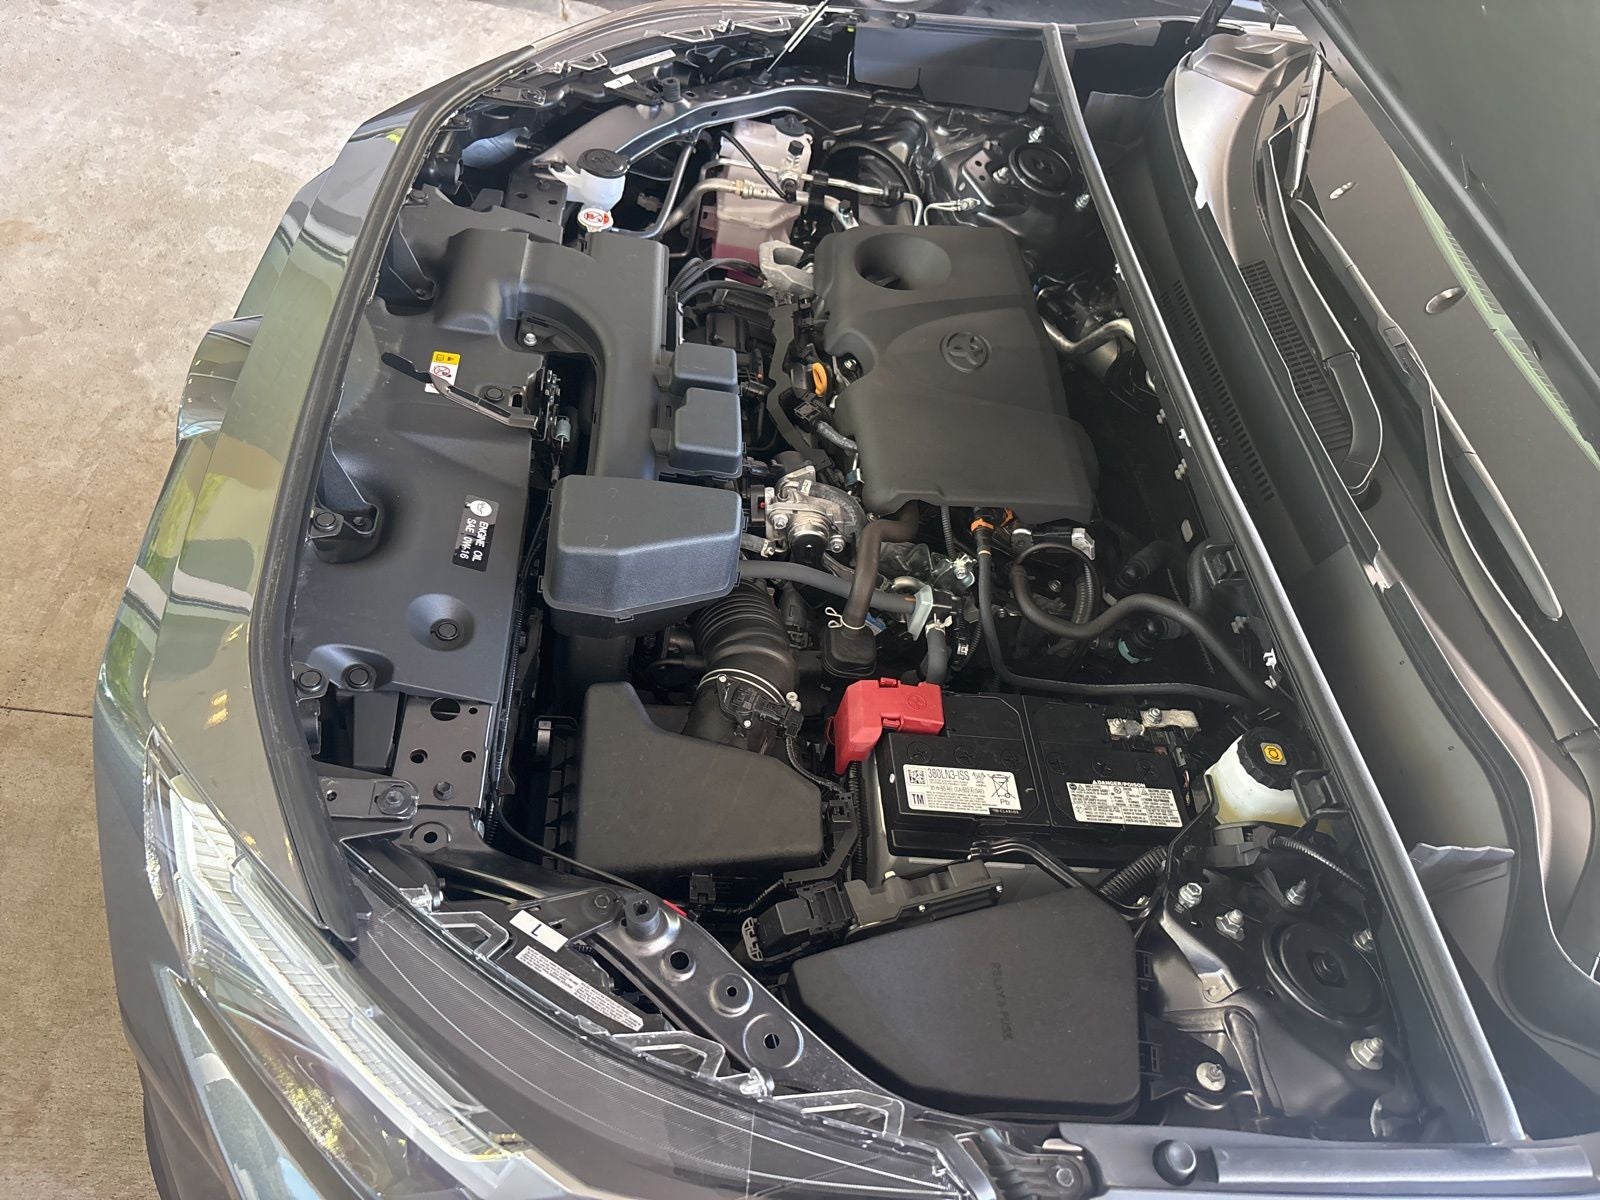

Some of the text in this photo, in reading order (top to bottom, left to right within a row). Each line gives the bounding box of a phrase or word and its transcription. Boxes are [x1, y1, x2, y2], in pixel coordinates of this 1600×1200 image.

[460, 518, 476, 560] SAE 0W-16
[472, 521, 489, 562] ENGINE OIL
[911, 793, 925, 805] TM
[530, 923, 543, 937] L
